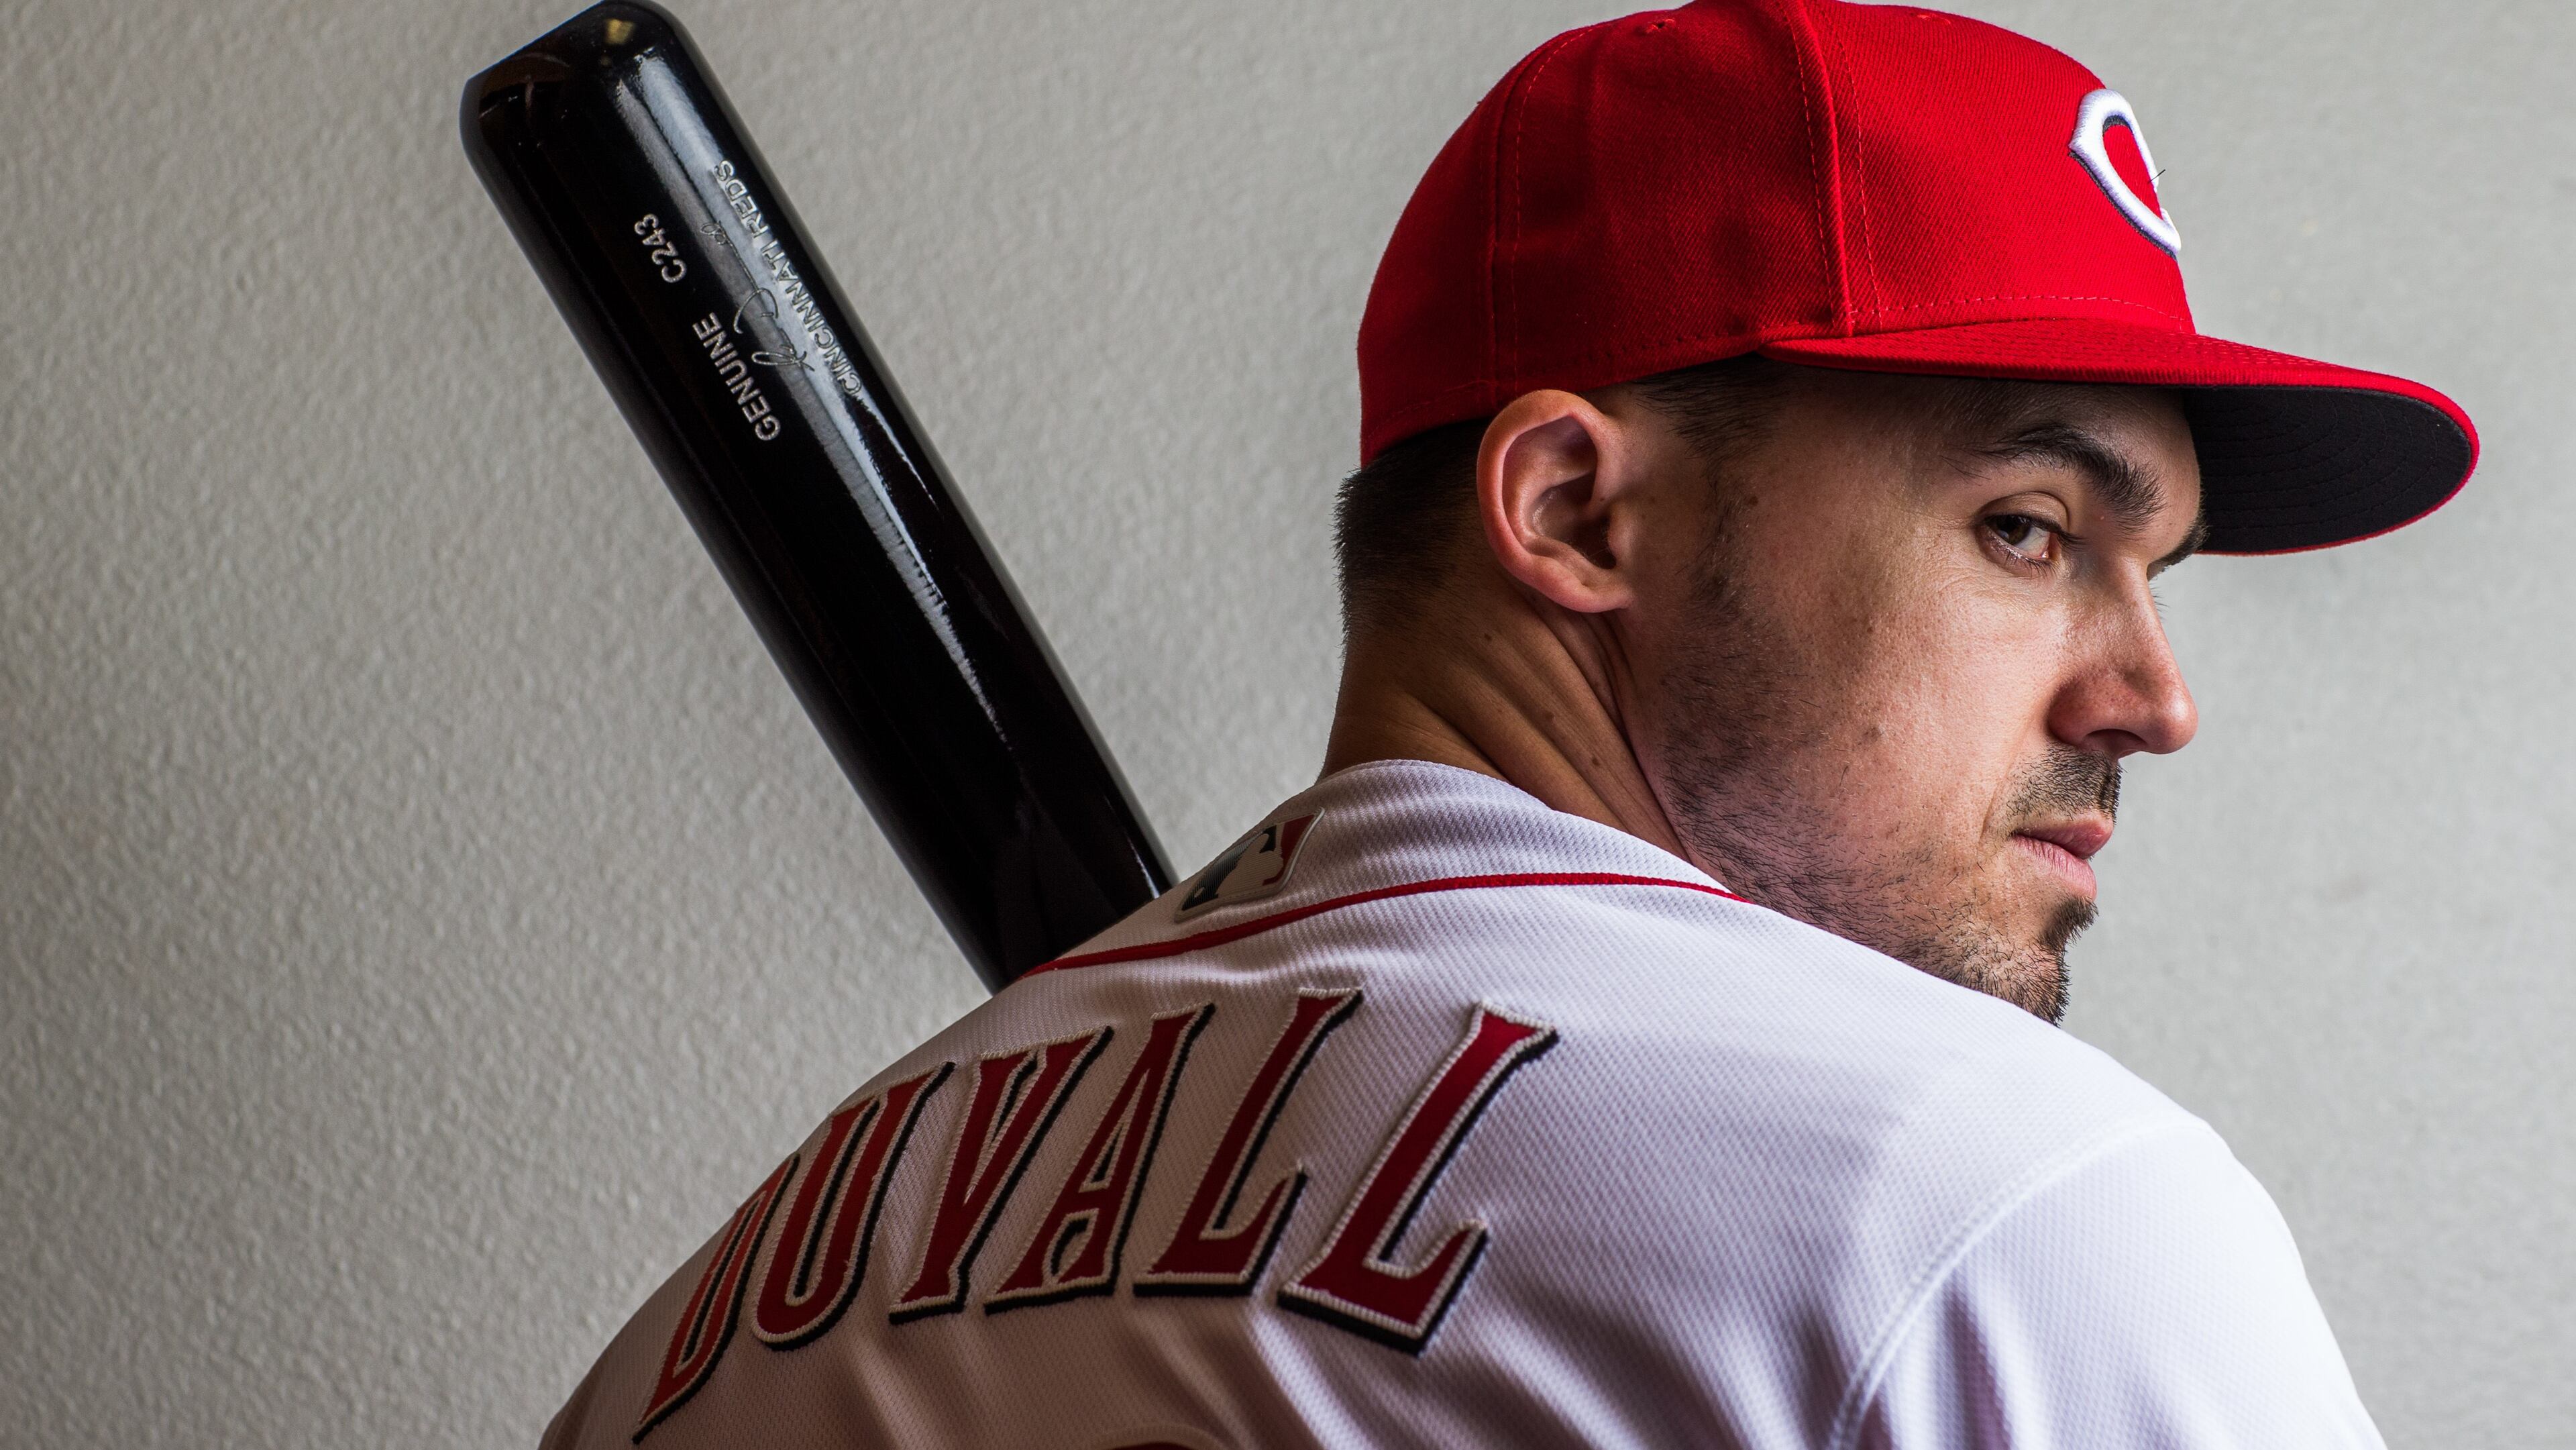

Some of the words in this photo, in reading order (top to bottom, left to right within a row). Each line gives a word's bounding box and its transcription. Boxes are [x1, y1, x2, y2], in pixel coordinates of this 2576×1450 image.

[633, 213, 687, 283] C243
[714, 160, 769, 240] REDS
[692, 312, 781, 442] GENUINE
[761, 242, 863, 396] CINCINNATI
[632, 986, 1558, 1445] DUVALL
